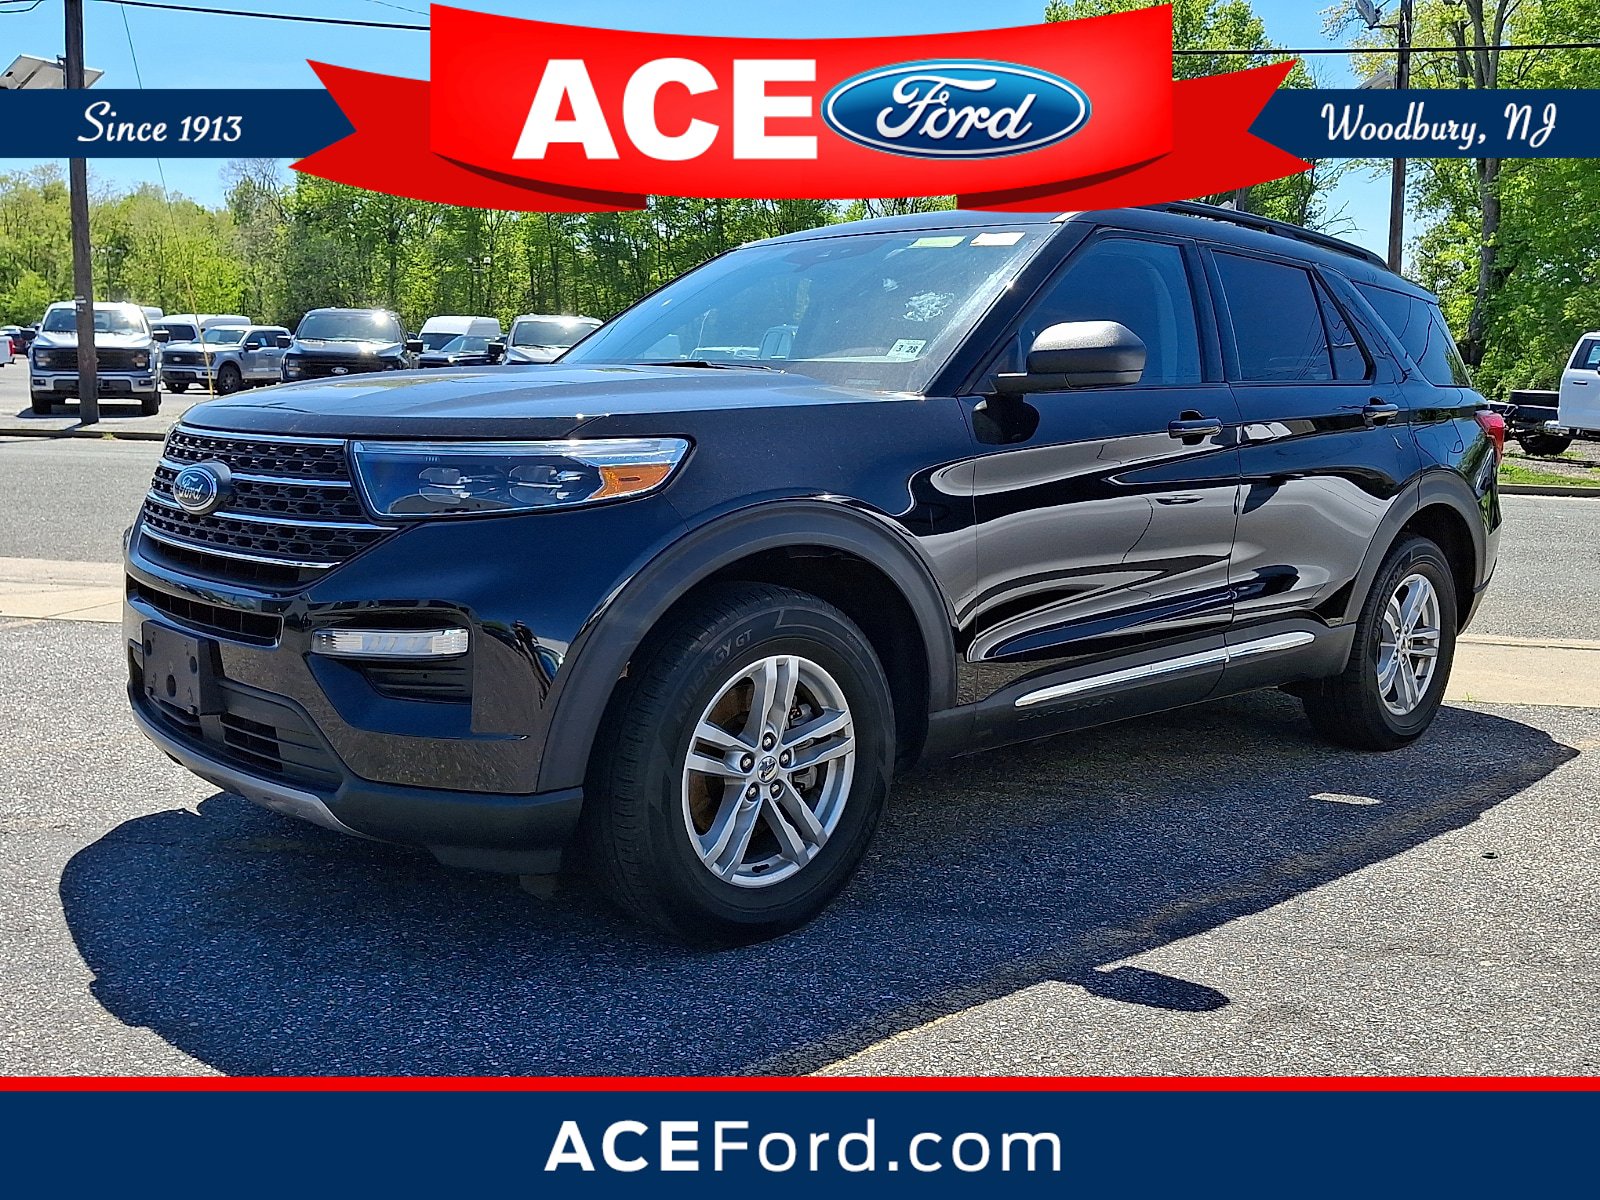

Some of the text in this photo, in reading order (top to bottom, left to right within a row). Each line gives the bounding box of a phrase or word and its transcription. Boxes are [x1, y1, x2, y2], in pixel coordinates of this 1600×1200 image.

[895, 344, 919, 354] 3 28
[178, 475, 204, 501] Ford
[735, 628, 753, 648] GT
